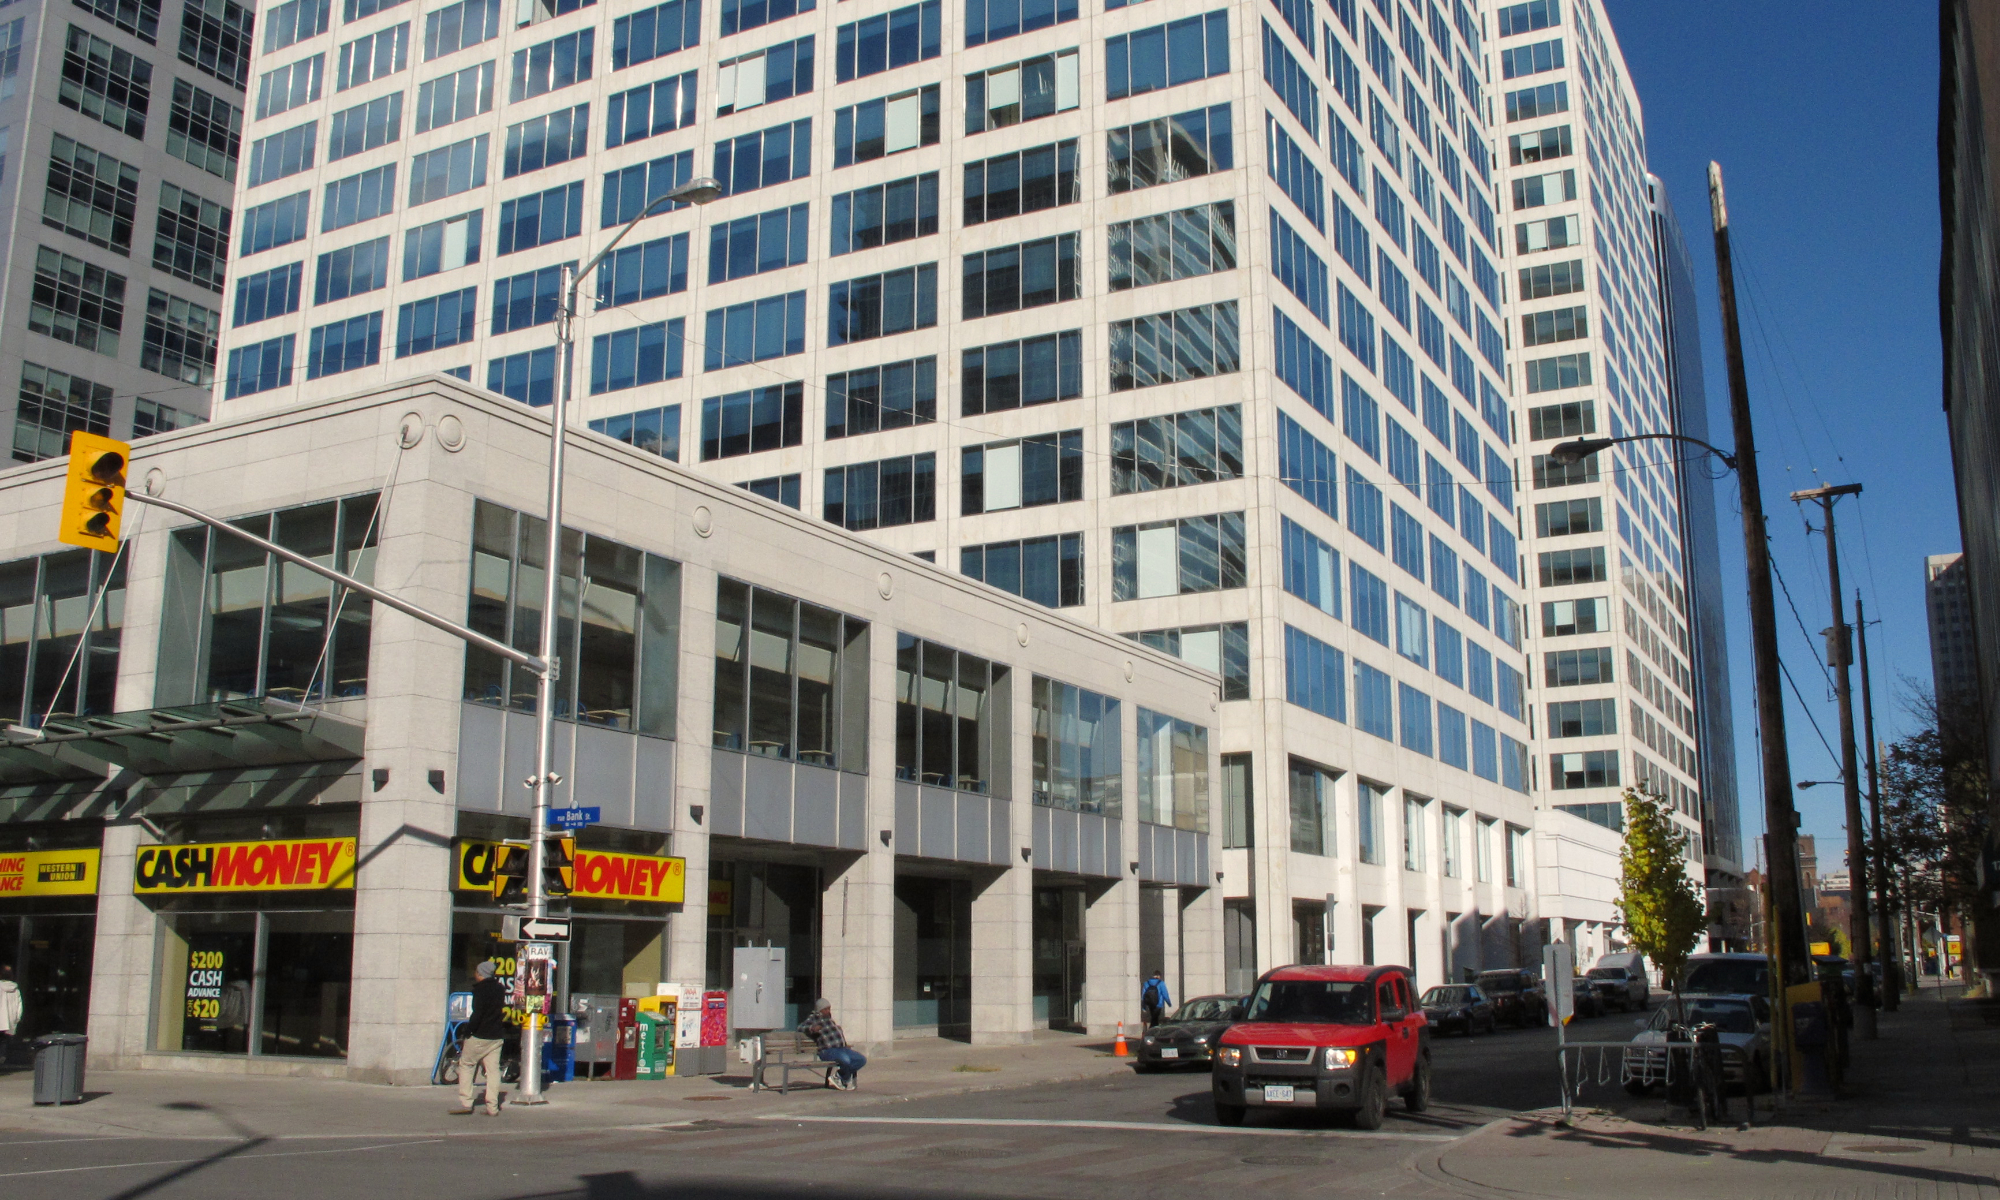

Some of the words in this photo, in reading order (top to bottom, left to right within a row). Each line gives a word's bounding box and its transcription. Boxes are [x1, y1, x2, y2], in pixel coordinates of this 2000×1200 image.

[566, 810, 583, 821] Bank
[40, 863, 76, 873] WESTERN
[50, 872, 75, 881] UNION
[191, 951, 224, 969] $200
[189, 970, 222, 986] CASH
[187, 988, 220, 998] ADVANCE
[193, 999, 220, 1018] $20
